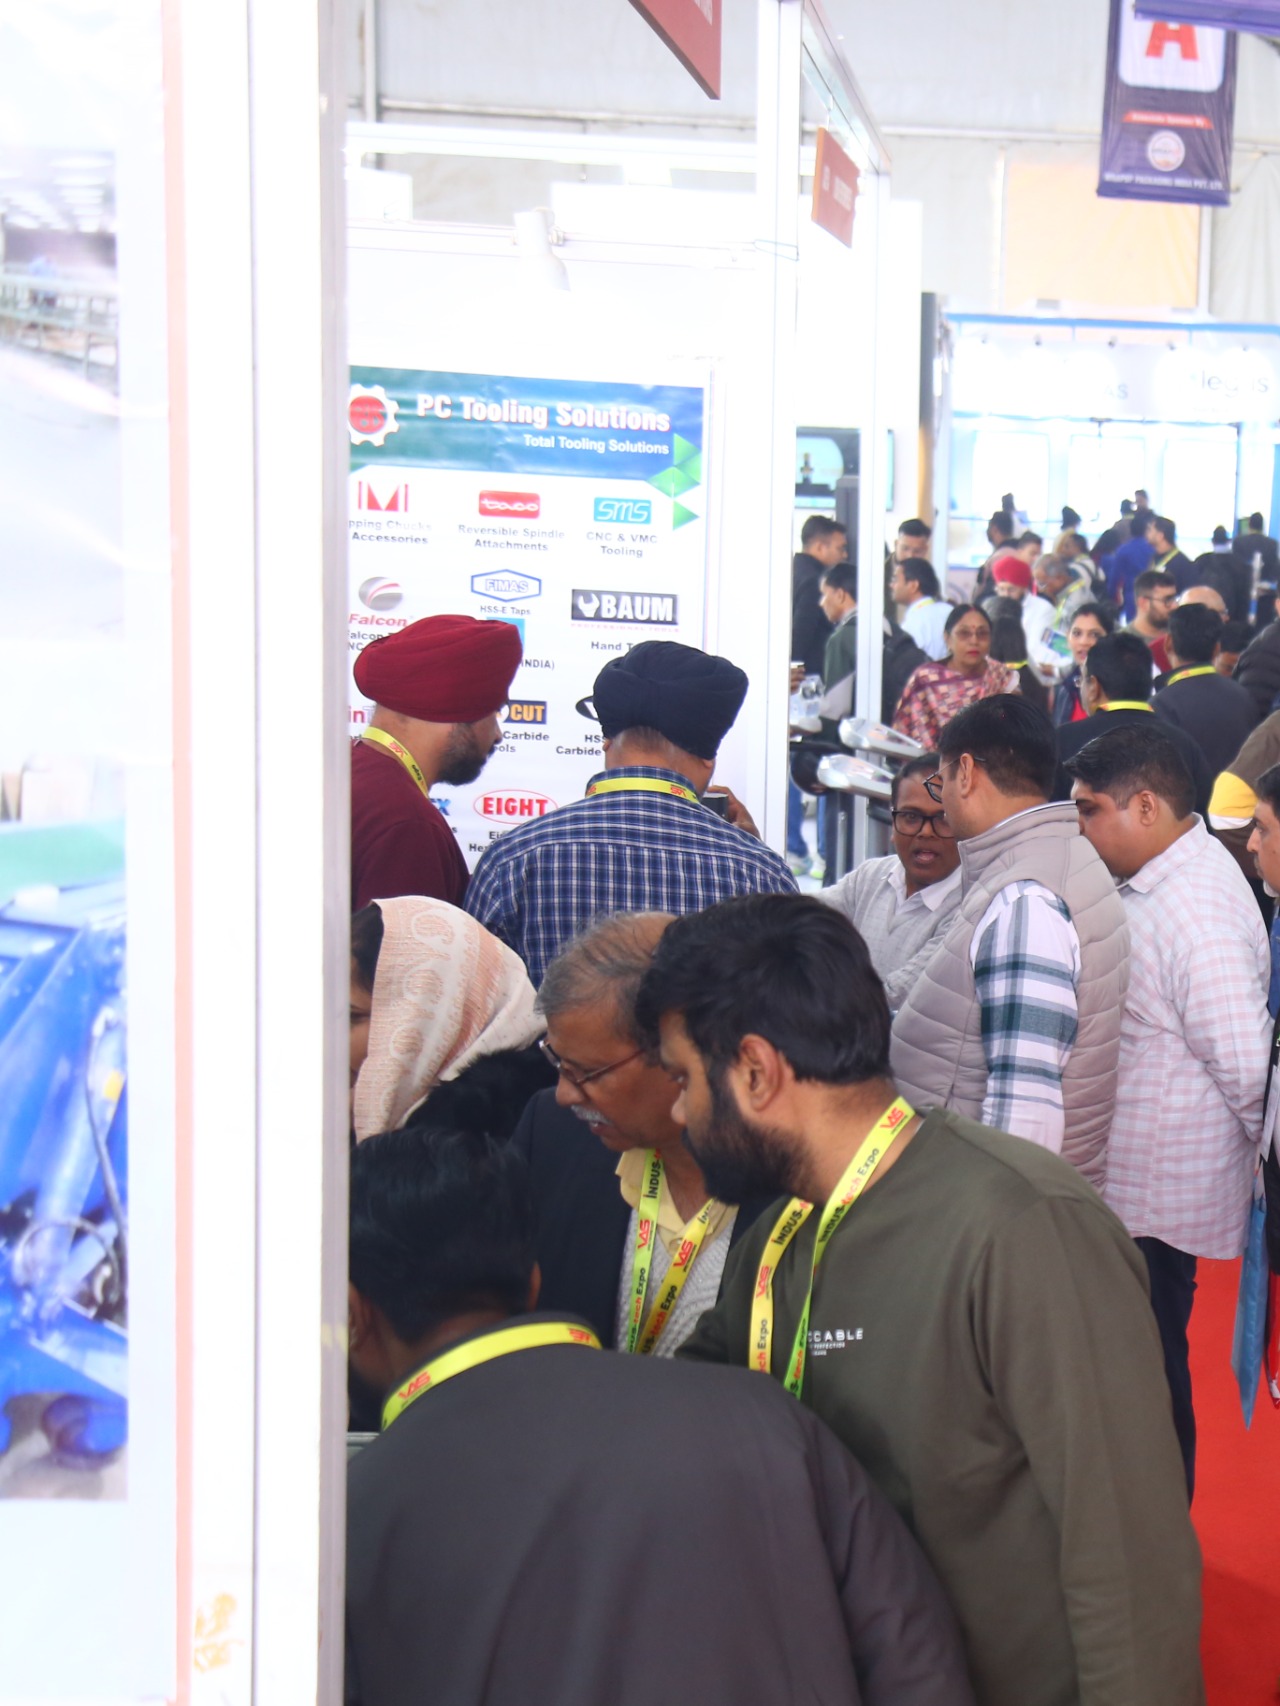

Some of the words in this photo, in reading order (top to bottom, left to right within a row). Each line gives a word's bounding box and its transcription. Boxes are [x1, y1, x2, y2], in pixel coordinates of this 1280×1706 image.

[1145, 21, 1199, 61] A
[417, 394, 452, 419] PC
[460, 396, 548, 429] Tooling
[555, 402, 671, 432] Solutions
[523, 434, 555, 448] Total
[559, 436, 606, 453] Tooling
[608, 438, 670, 455] Solutions
[348, 519, 382, 531] pping
[386, 520, 433, 532] Chucks
[458, 524, 518, 538] Reversible
[522, 528, 565, 540] Spindle
[352, 532, 429, 545] Accessories
[474, 538, 549, 552] Attachments
[586, 532, 613, 542] CNC
[617, 533, 626, 542] &
[630, 534, 658, 544] VMC
[600, 545, 643, 559] Tooling
[485, 578, 529, 593] FIMAS
[510, 606, 531, 616] Taps
[601, 594, 673, 622] BAUM
[348, 613, 408, 627] Falcon
[348, 630, 384, 641] alcon
[591, 640, 622, 651] Hand
[520, 658, 555, 670] INDIA)
[503, 731, 550, 743] Carbide
[556, 745, 602, 757] Carbide
[483, 797, 548, 816] EIGHT
[881, 1107, 904, 1131] VAS
[857, 1147, 880, 1176] Expo
[637, 1219, 650, 1249] VAS
[674, 1239, 694, 1267] VAS
[636, 1267, 646, 1296] Expo
[756, 1265, 770, 1299] VAS
[661, 1285, 677, 1311] Expo
[757, 1318, 768, 1350] Expo
[398, 1371, 431, 1399] VAS
